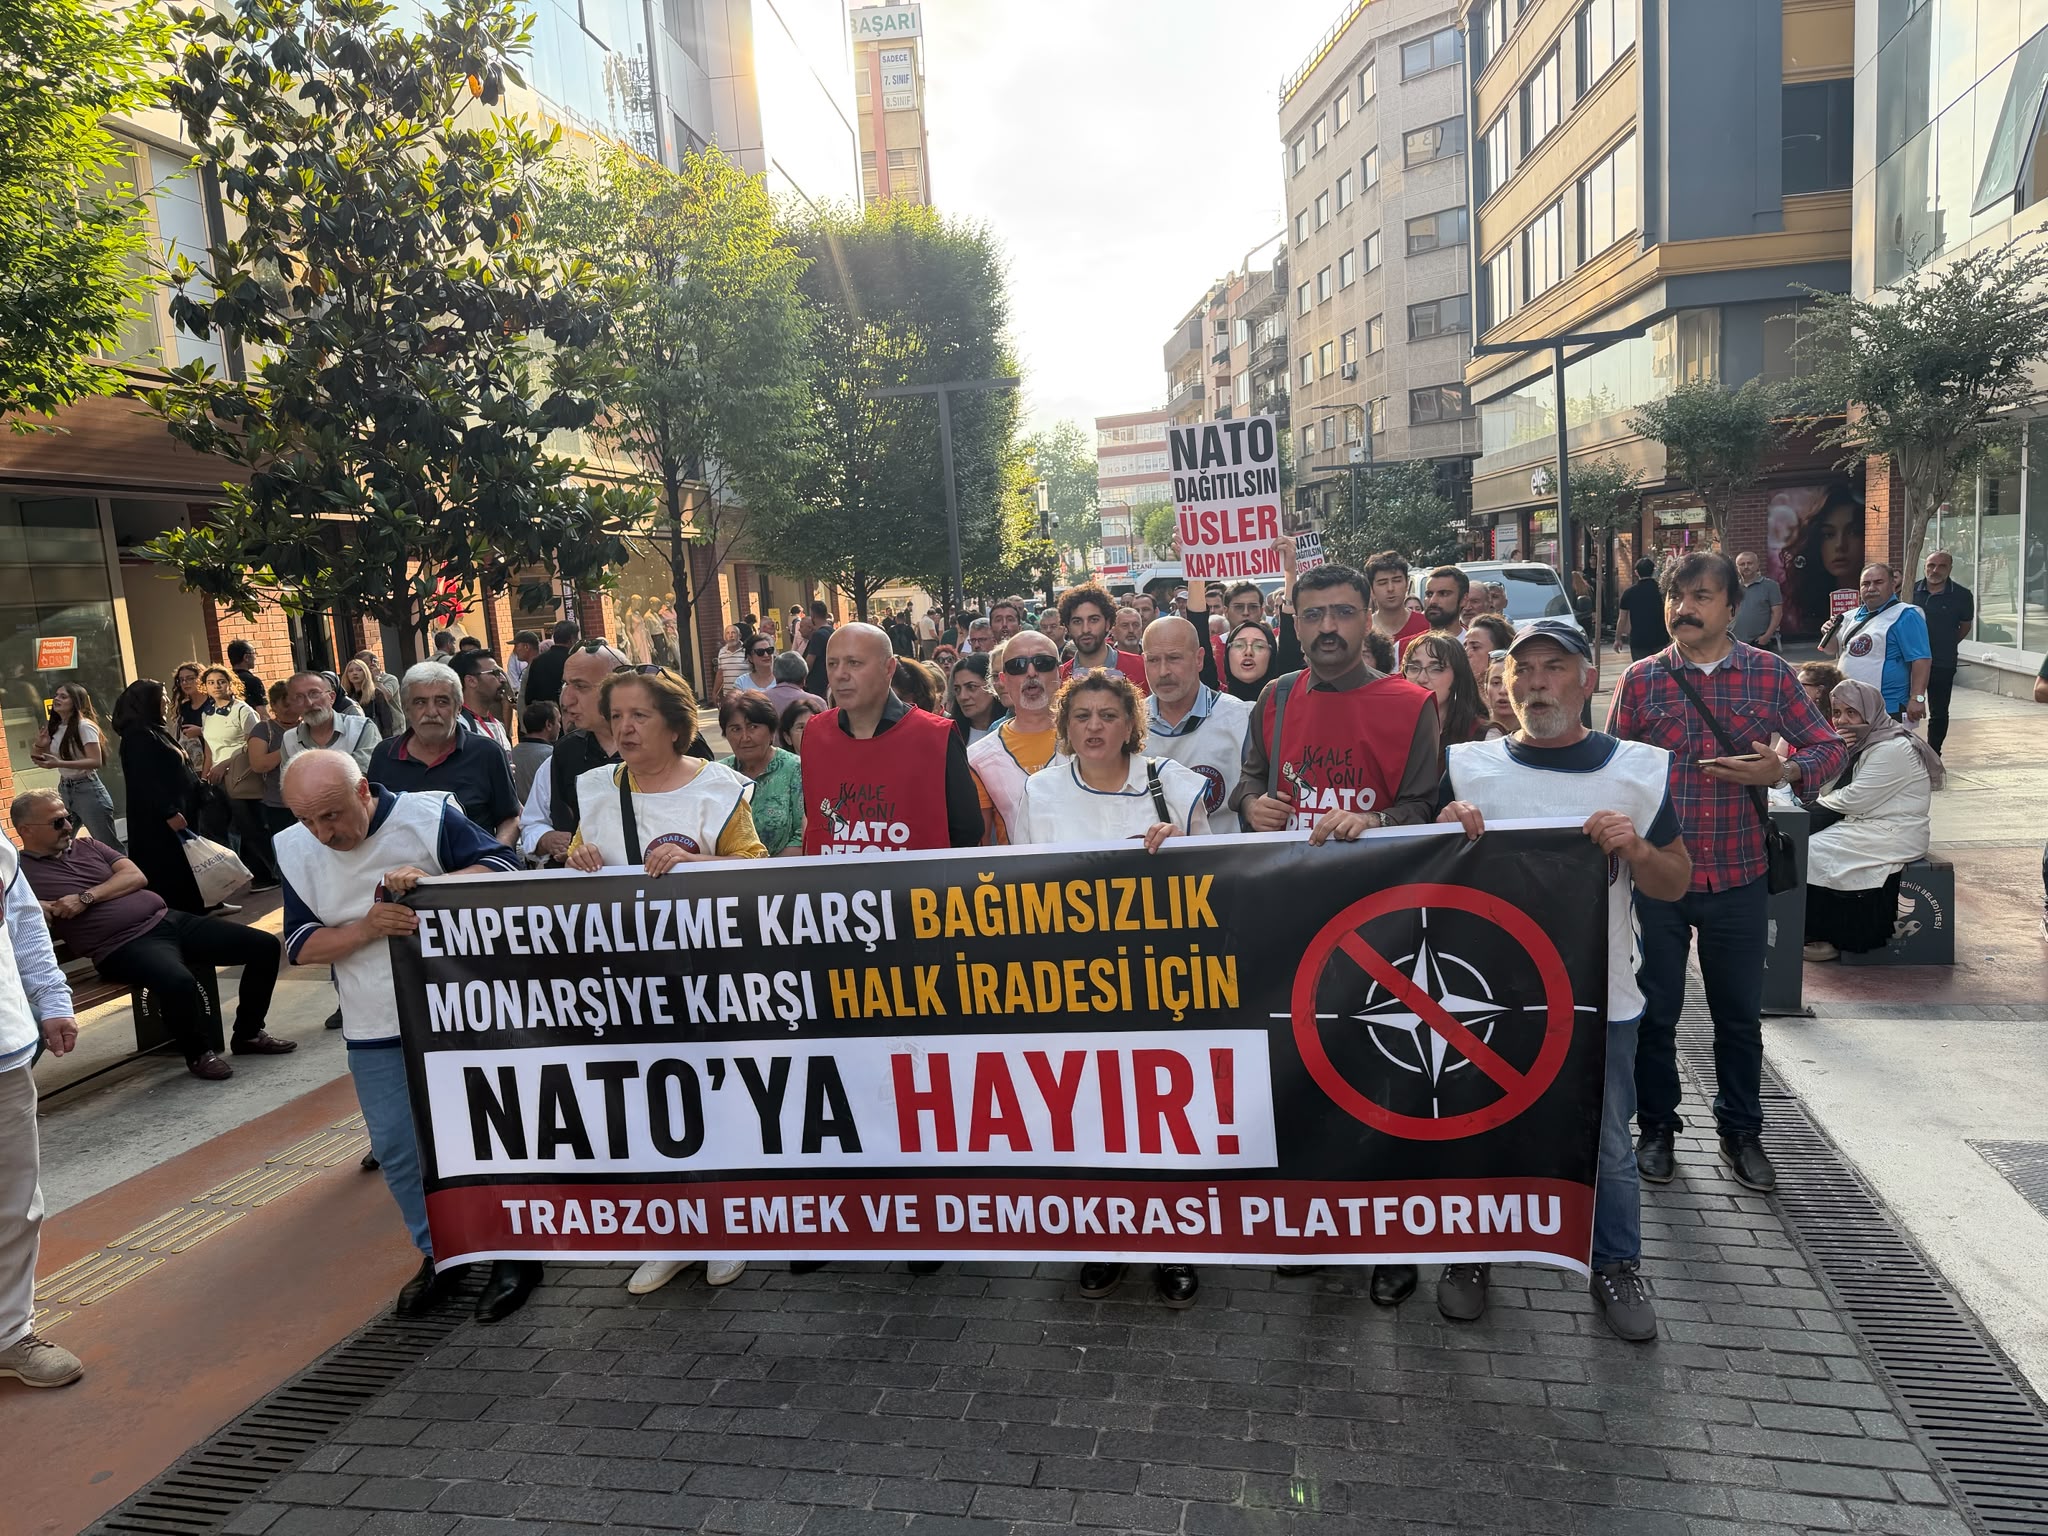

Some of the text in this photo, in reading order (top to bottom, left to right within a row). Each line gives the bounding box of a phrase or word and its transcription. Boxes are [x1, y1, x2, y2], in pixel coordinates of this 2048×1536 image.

[882, 53, 908, 63] SADECE
[884, 74, 910, 86] 7. SINIF
[1169, 418, 1274, 471] NATO
[1174, 467, 1277, 503] DAĞITILSIN
[1180, 505, 1279, 546] ÜSLER
[1185, 548, 1281, 578] KAPATILSIN
[1326, 767, 1363, 788] SON!
[858, 802, 896, 822] SON!
[1300, 787, 1377, 811] NATO
[657, 835, 695, 848] TRABZON
[833, 820, 910, 844] NATO
[416, 871, 1220, 958] EMPERYALİZME KARŞI BAĞIMSIZLIK
[1920, 888, 1943, 930] BELEDİYESİ
[425, 943, 1240, 1037] MONARŞİYE KARŞI HALK İRADESİ İÇİN
[463, 1047, 1240, 1162] NATO'YA HAYIR!
[501, 1187, 1562, 1237] TRABZON EMEK VE DEMOKRASİ PLATFORMU
